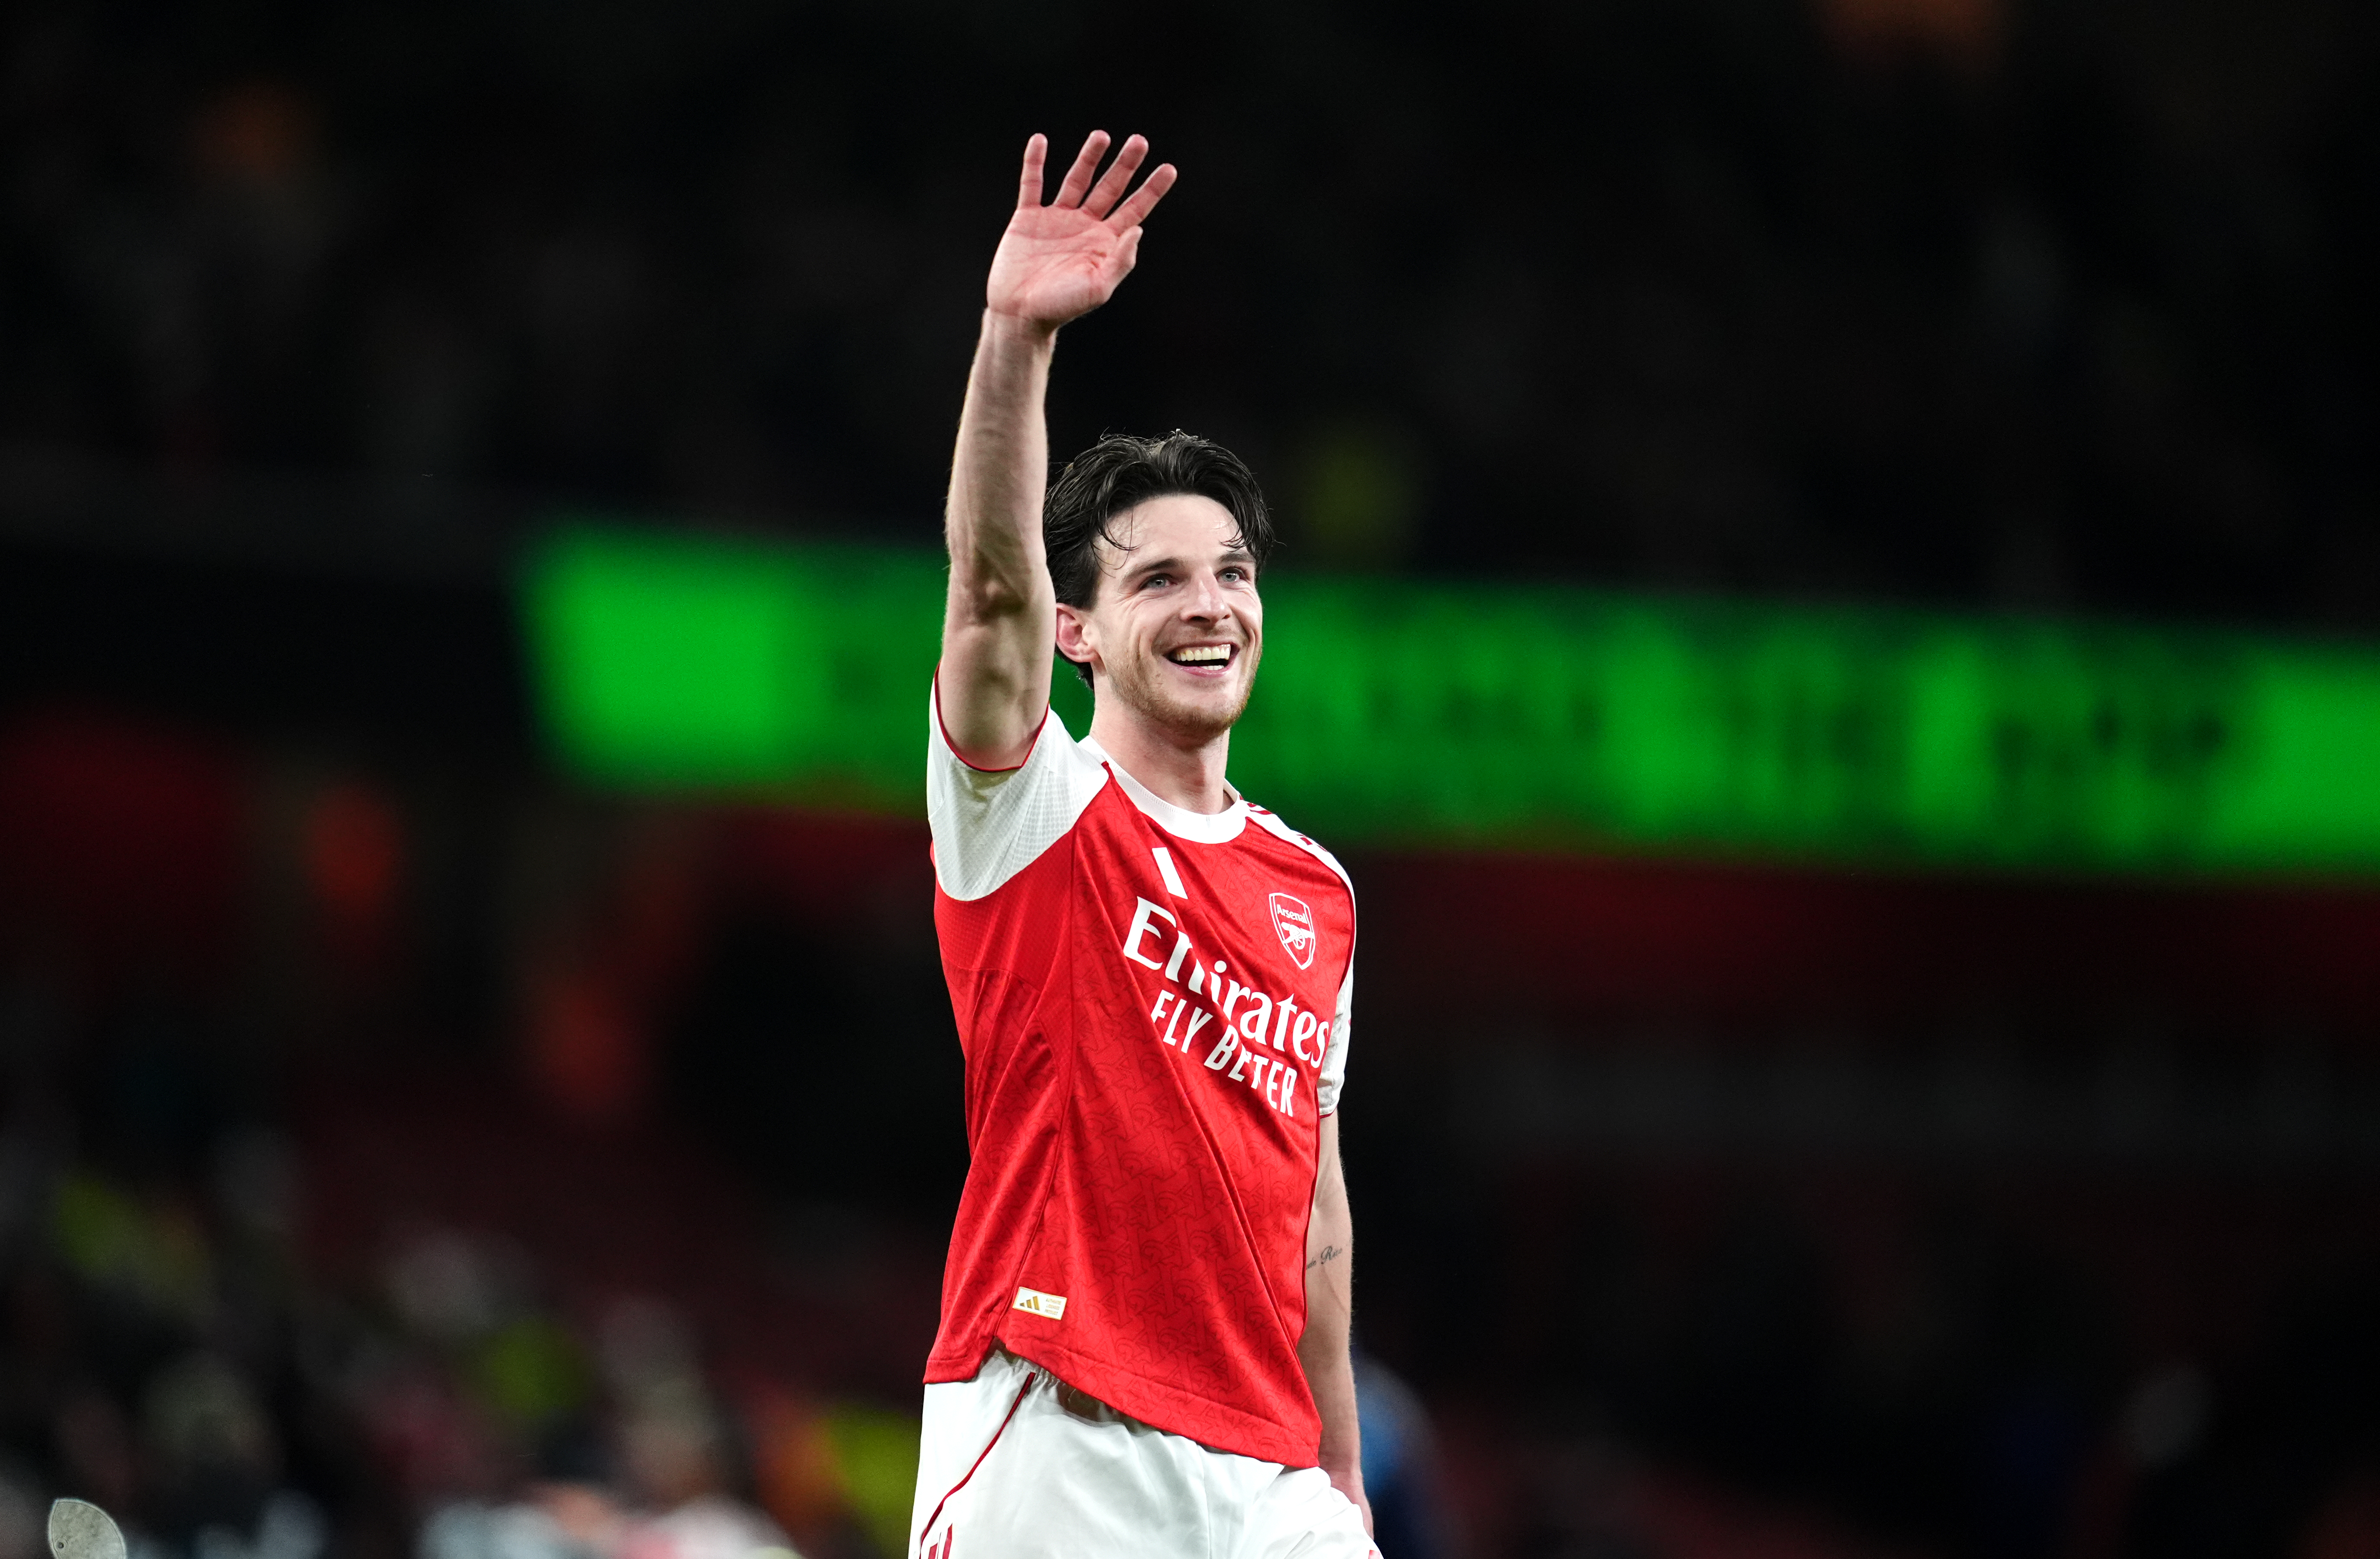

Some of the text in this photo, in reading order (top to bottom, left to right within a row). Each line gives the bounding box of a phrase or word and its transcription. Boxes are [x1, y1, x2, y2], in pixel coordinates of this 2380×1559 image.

[1276, 904, 1308, 924] Arsenal
[1123, 896, 1329, 1068] Emirates
[1150, 989, 1213, 1054] FLY
